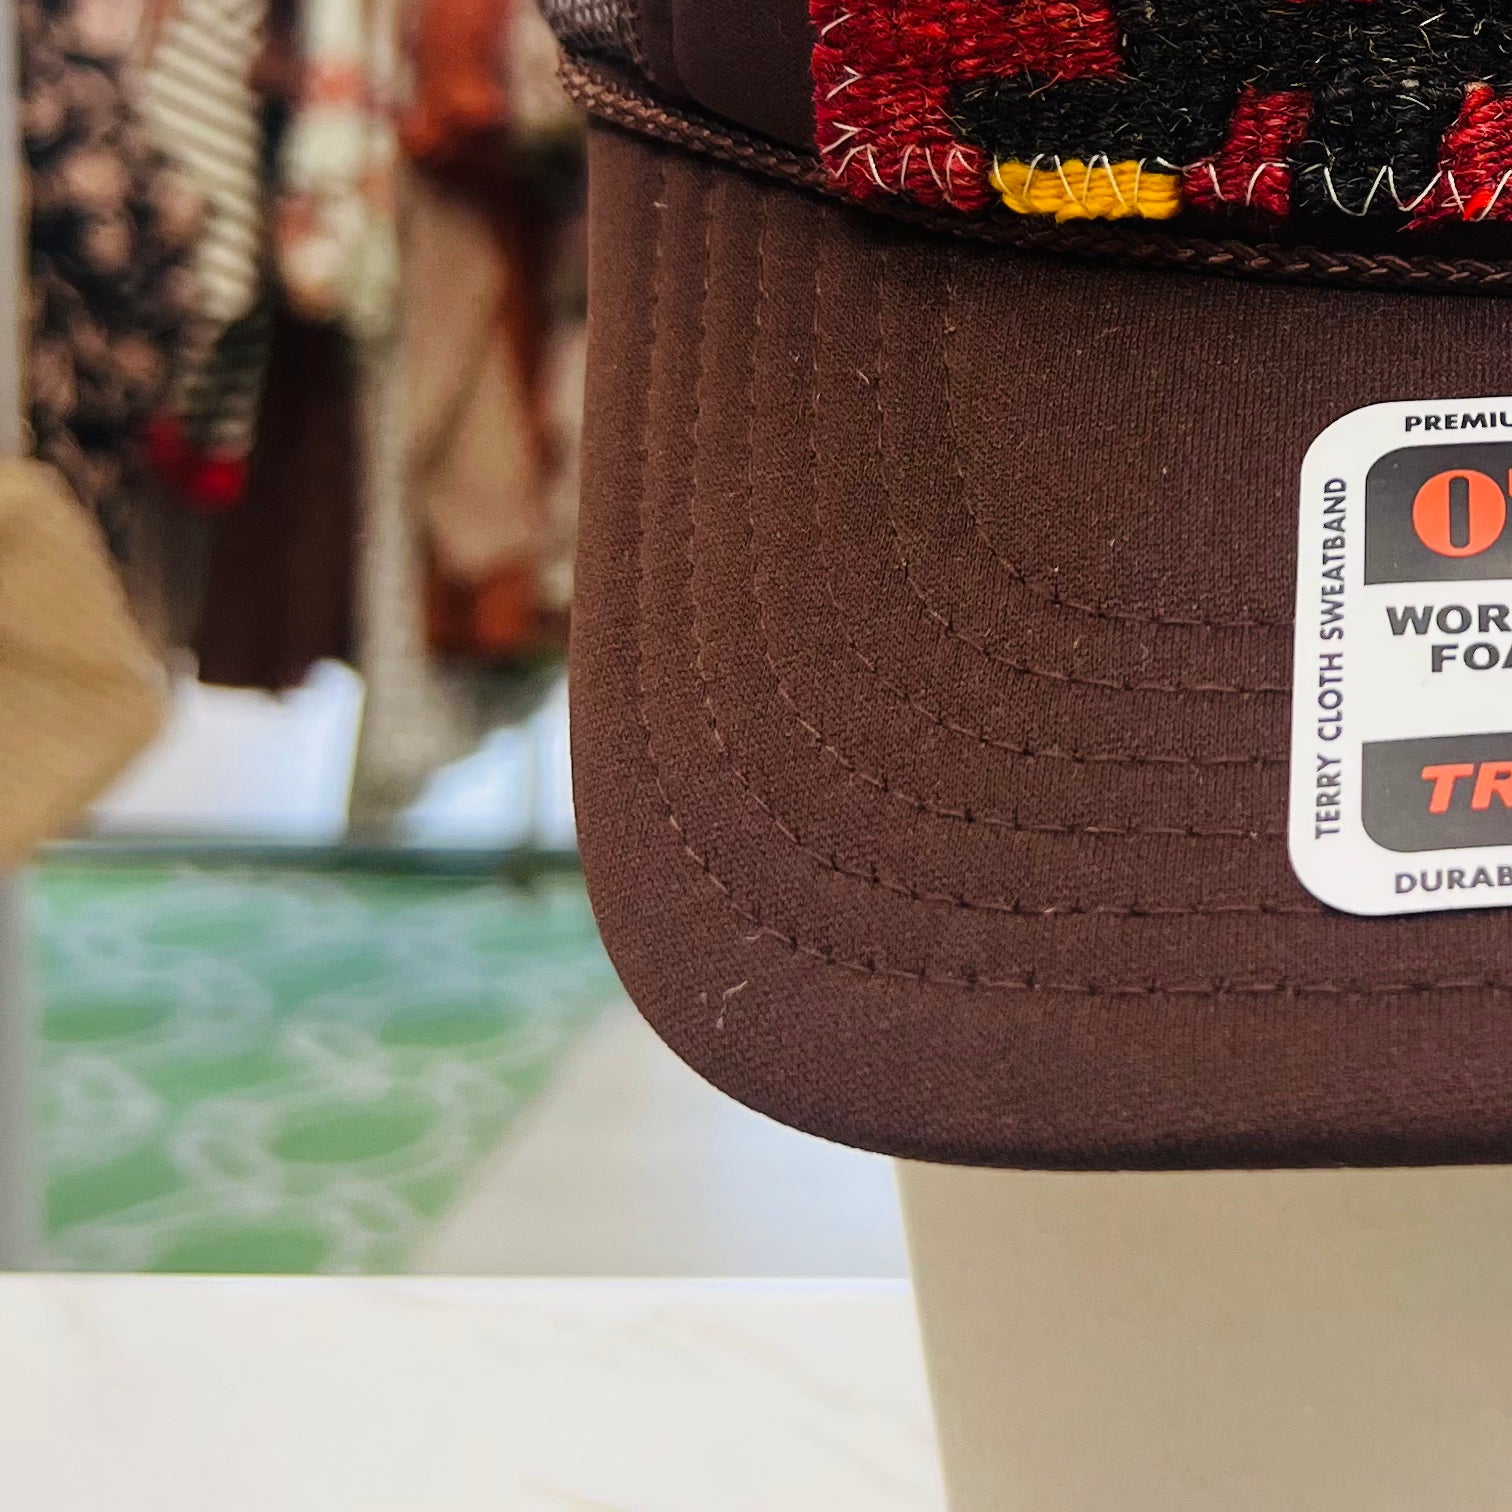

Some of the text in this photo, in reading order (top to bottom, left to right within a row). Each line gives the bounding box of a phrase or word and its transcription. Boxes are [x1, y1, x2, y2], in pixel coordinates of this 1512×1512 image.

[1314, 477, 1347, 840] TERRY CLOTH SWEATBAND
